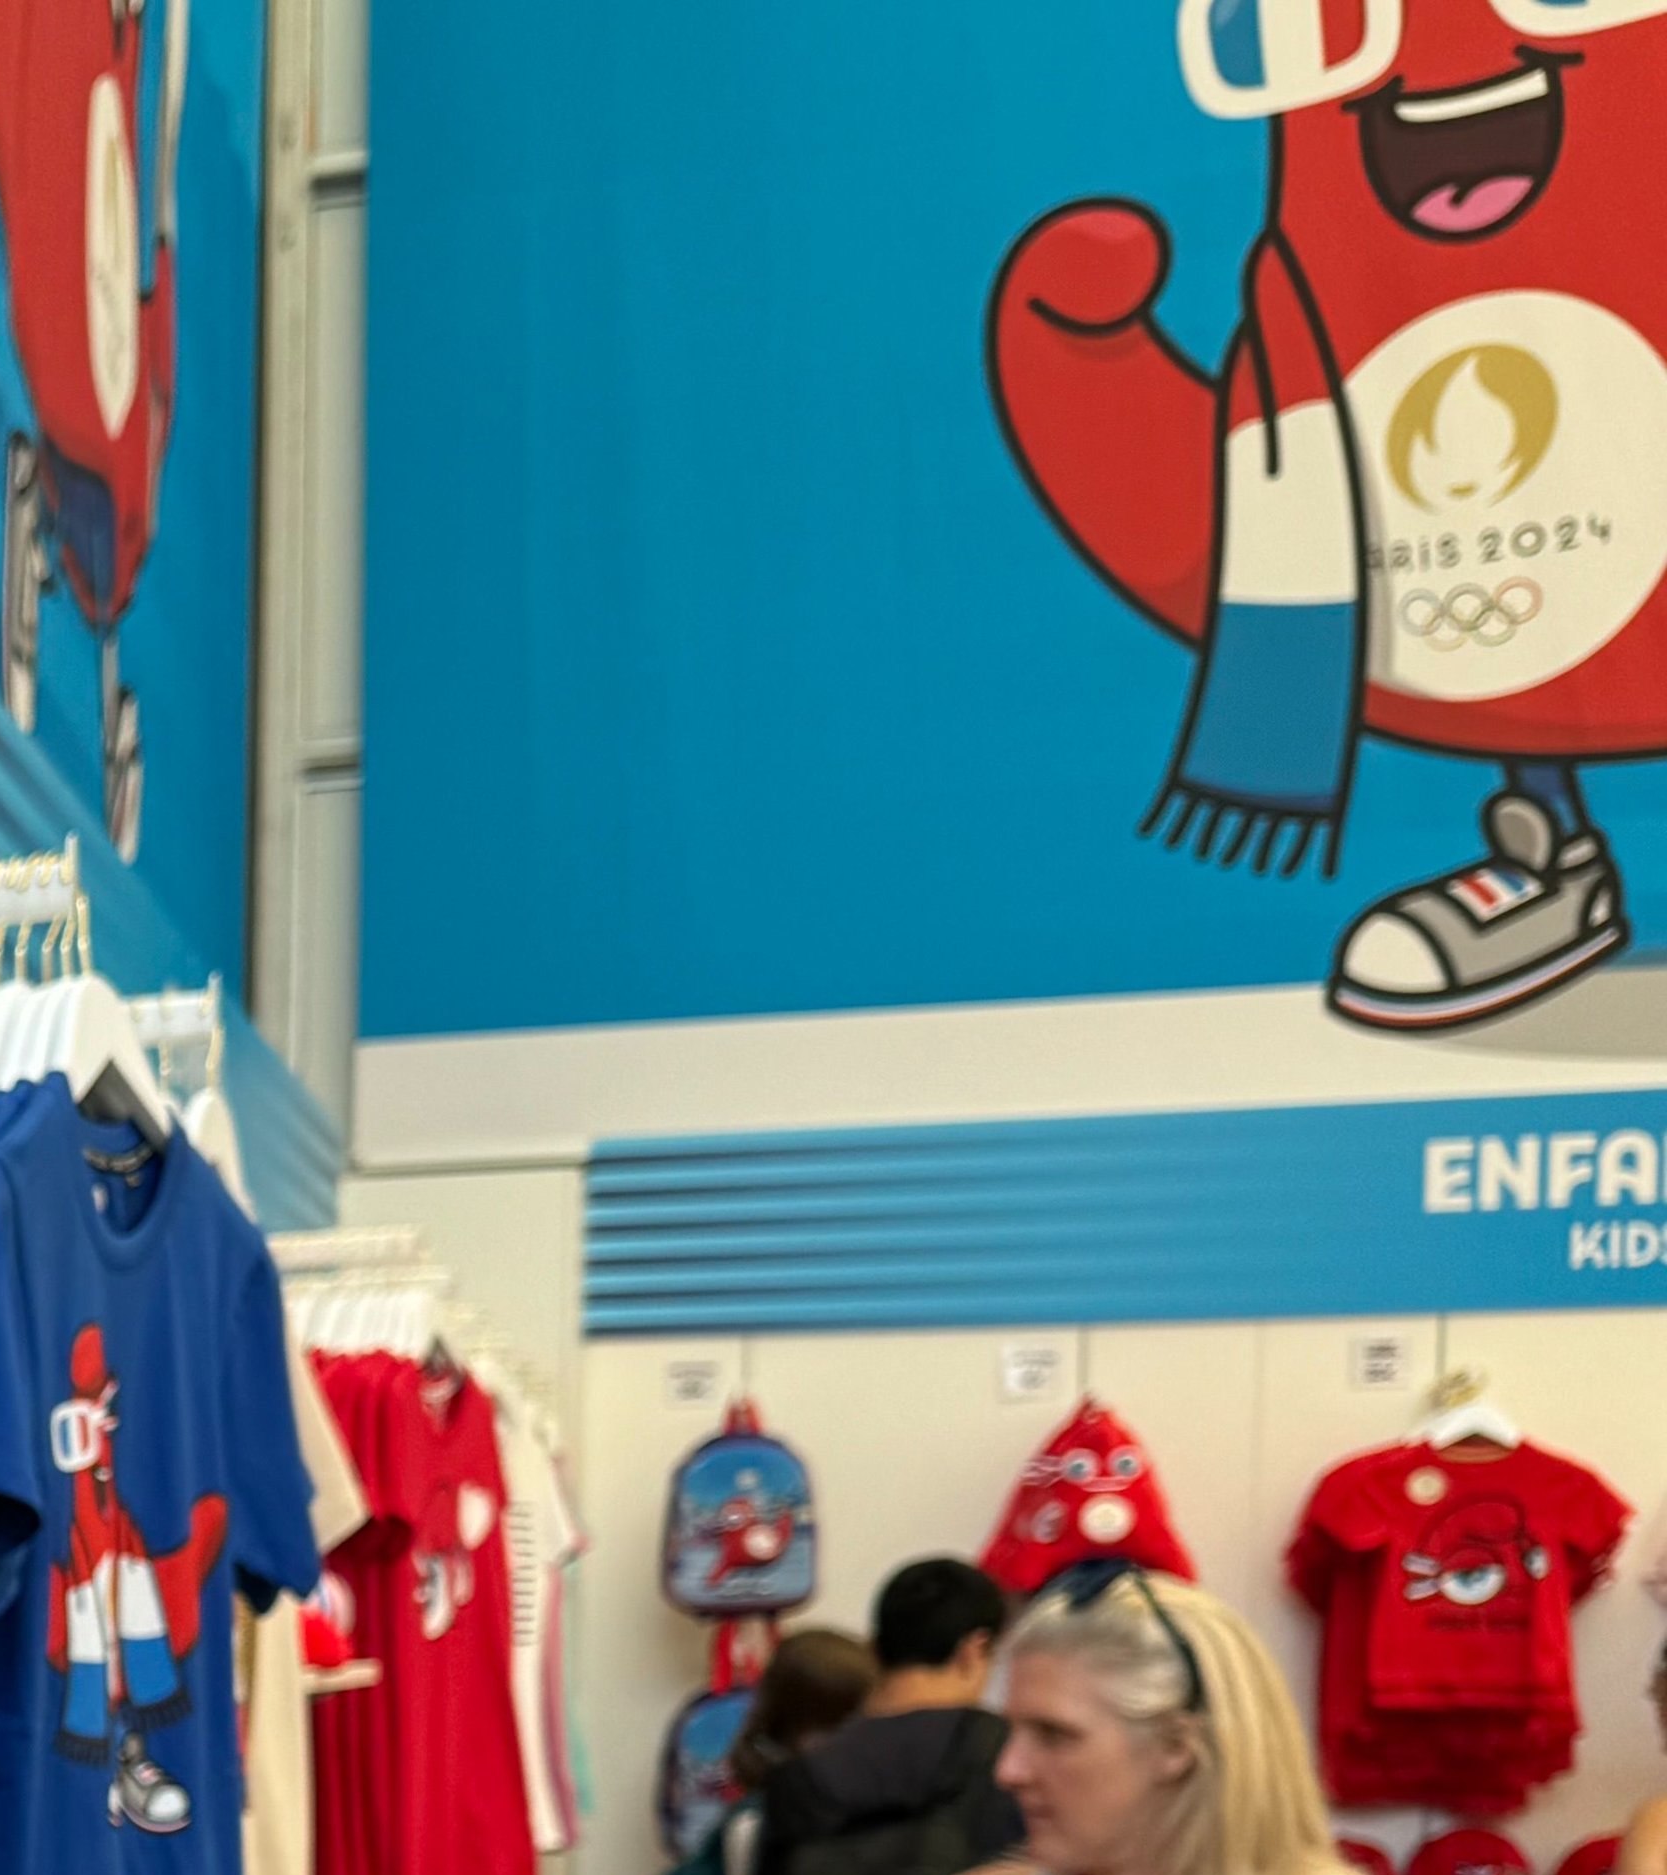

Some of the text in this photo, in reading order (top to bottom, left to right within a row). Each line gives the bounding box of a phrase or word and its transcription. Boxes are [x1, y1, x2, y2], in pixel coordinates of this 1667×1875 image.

[1477, 513, 1613, 563] 2024
[1423, 1127, 1667, 1215] ENFA
[1570, 1219, 1667, 1271] KID
